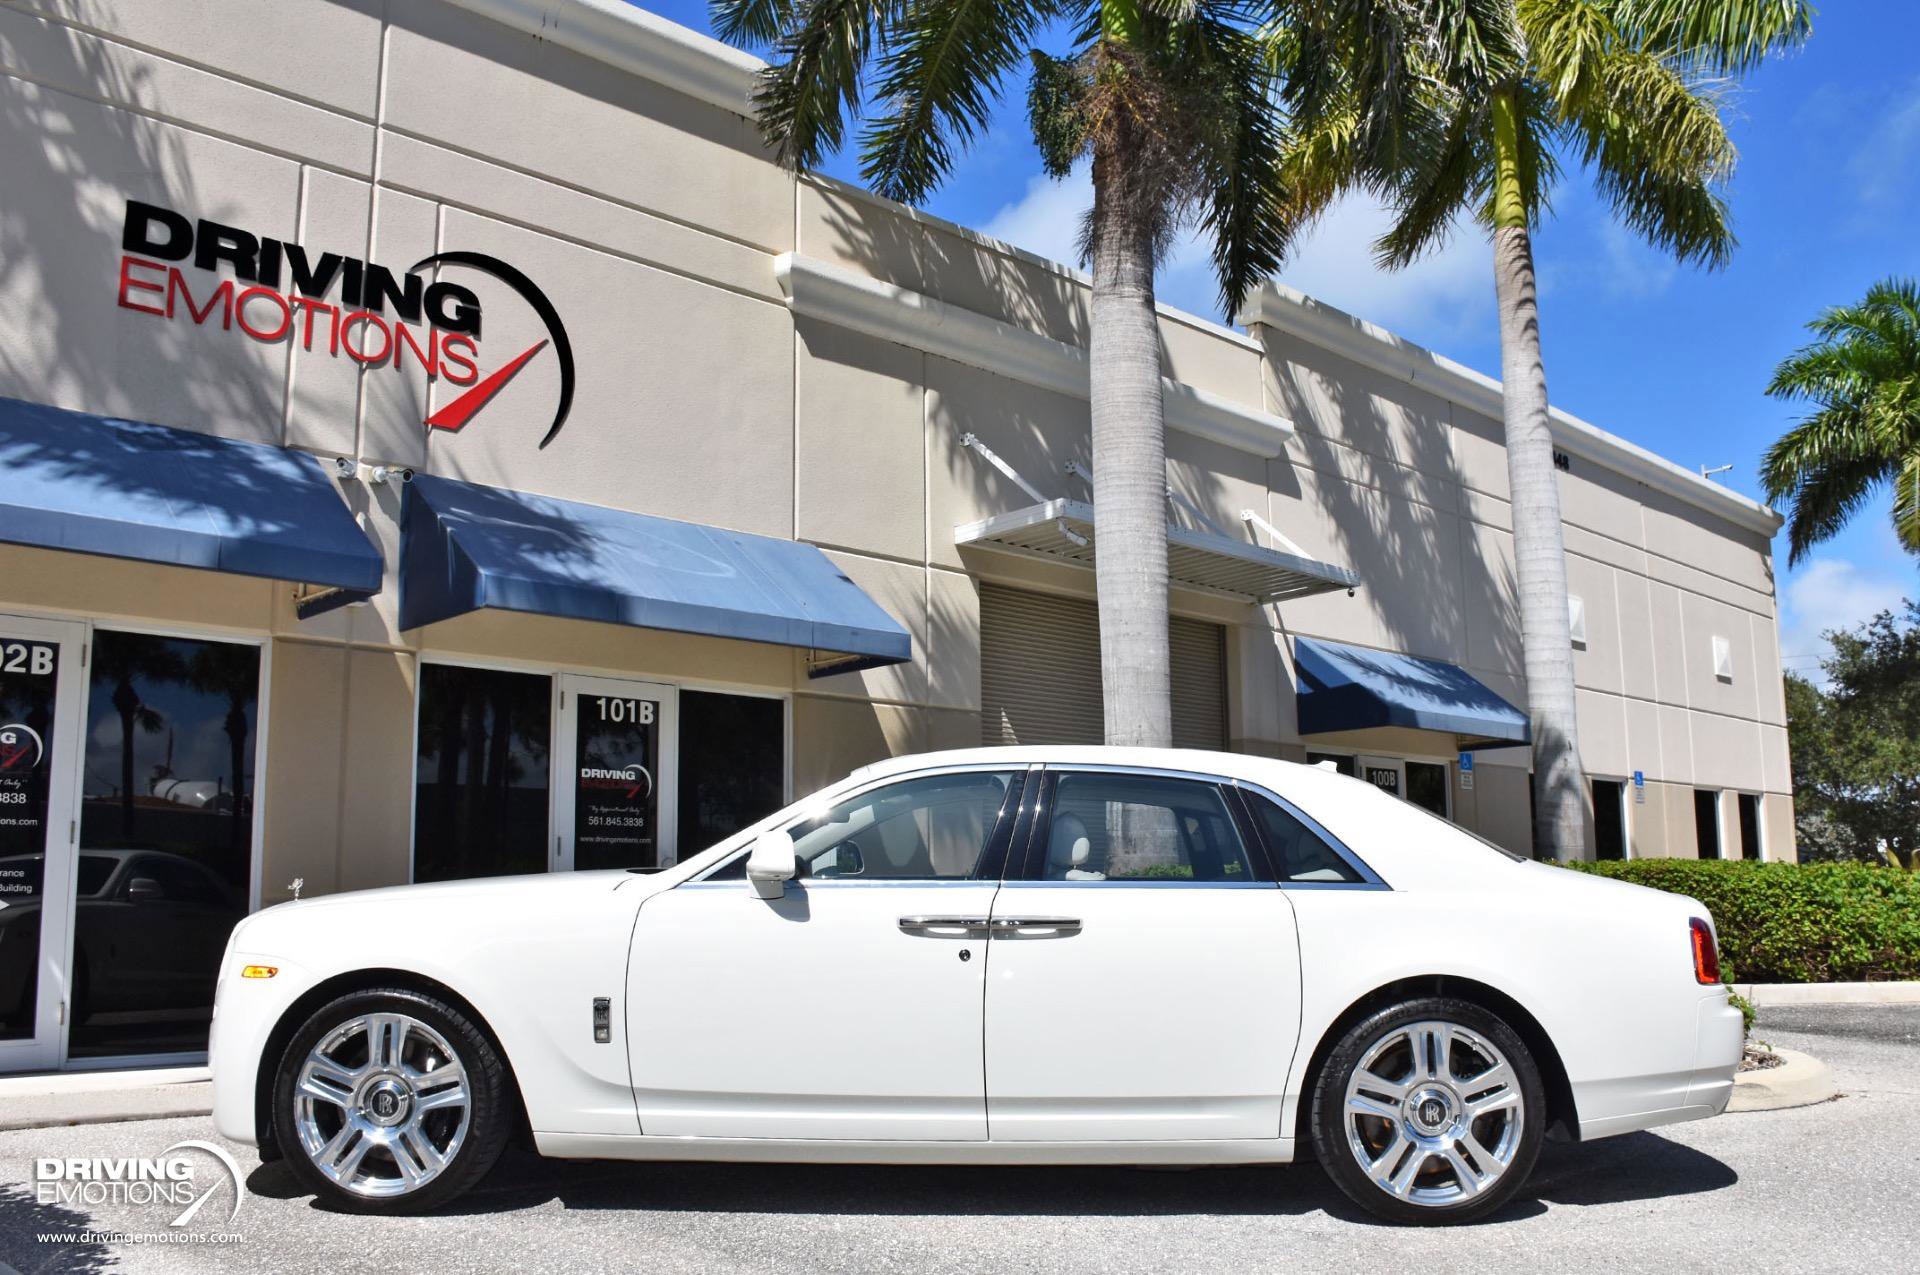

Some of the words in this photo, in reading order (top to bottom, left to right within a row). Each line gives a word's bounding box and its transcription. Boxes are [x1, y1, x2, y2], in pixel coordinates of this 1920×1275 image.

[122, 200, 482, 341] DRIVING
[117, 255, 480, 386] EMOTIONS
[0, 644, 54, 675] 2B
[596, 698, 654, 725] 101B
[581, 768, 636, 780] DRIVING
[1373, 770, 1396, 786] 100B
